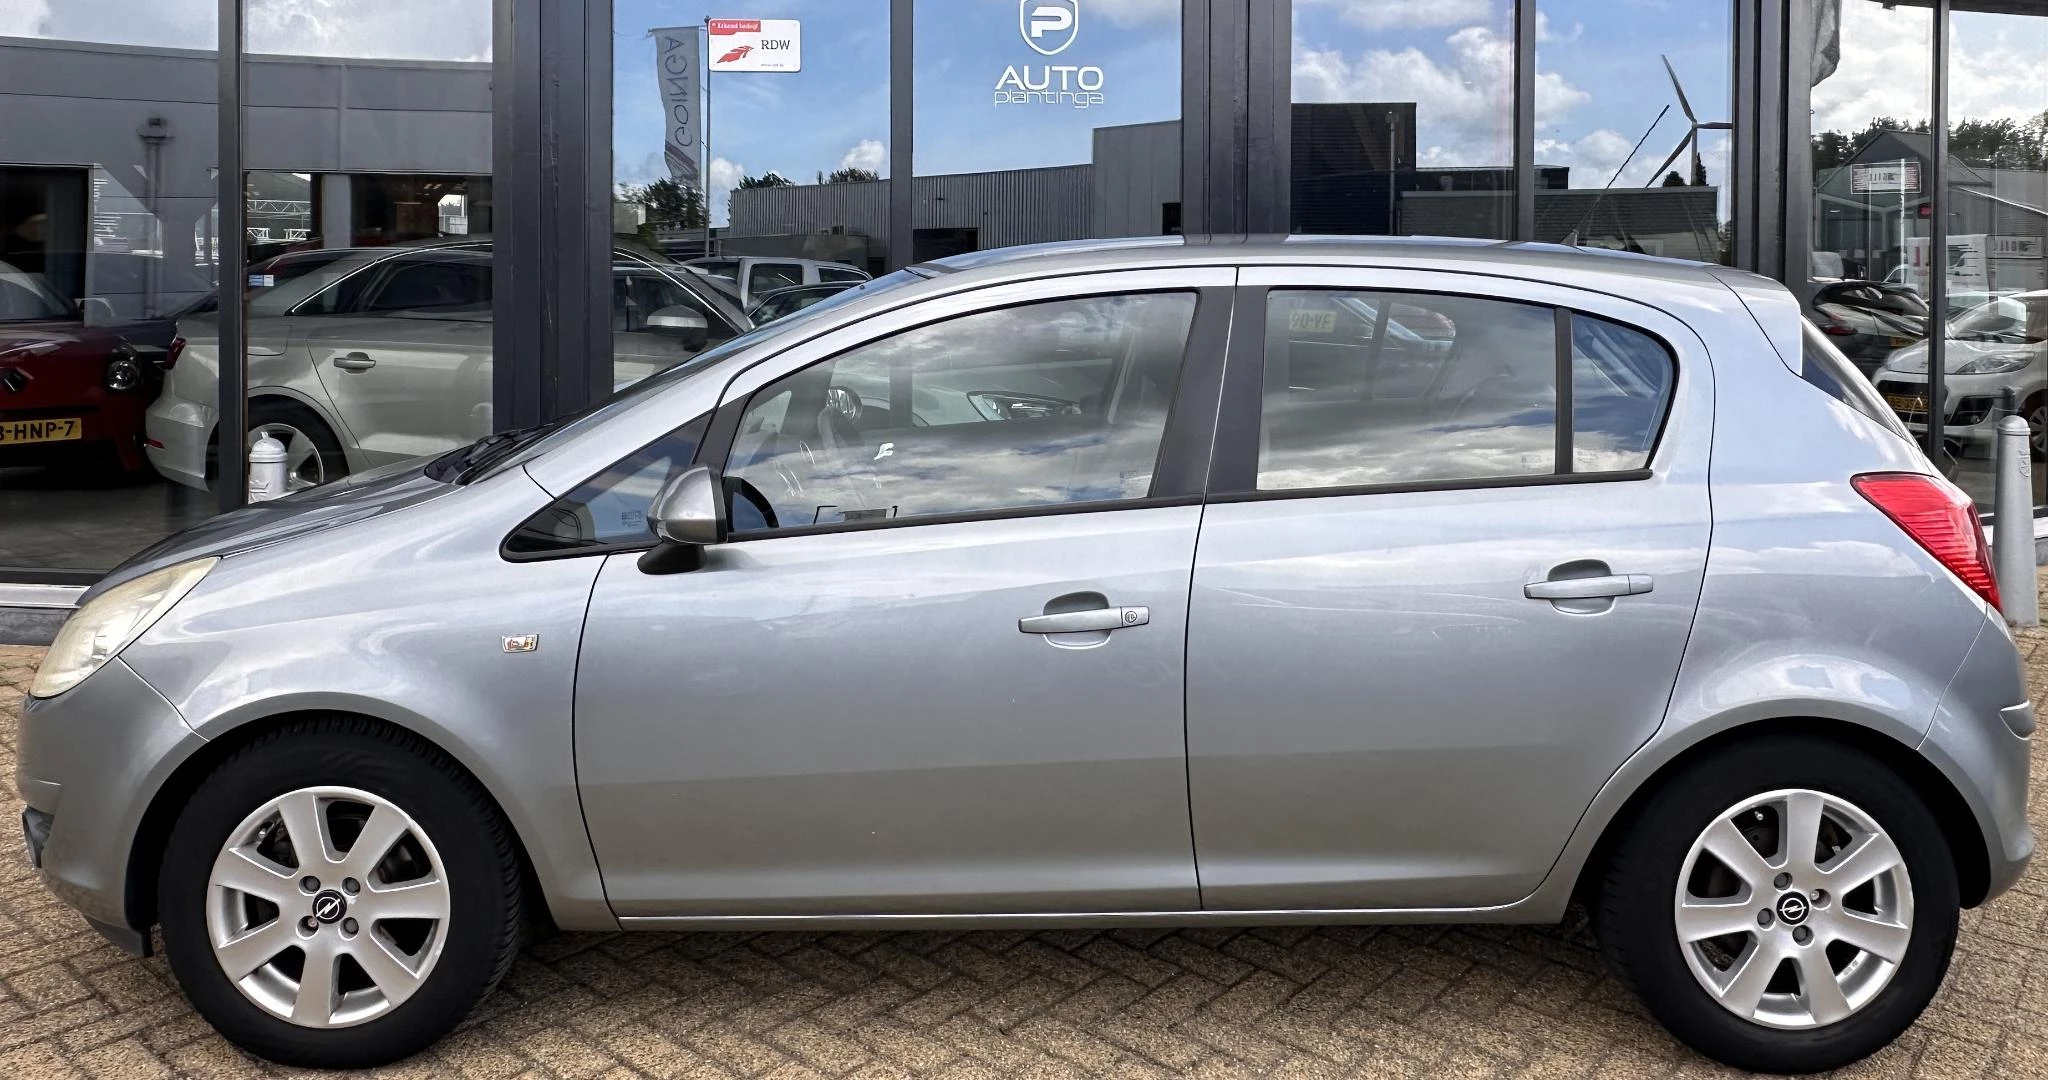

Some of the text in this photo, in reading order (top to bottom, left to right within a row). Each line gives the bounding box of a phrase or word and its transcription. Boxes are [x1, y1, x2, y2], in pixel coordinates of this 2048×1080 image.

[761, 39, 791, 51] RDW
[994, 64, 1104, 91] AUTO
[994, 89, 1104, 109] plantinga
